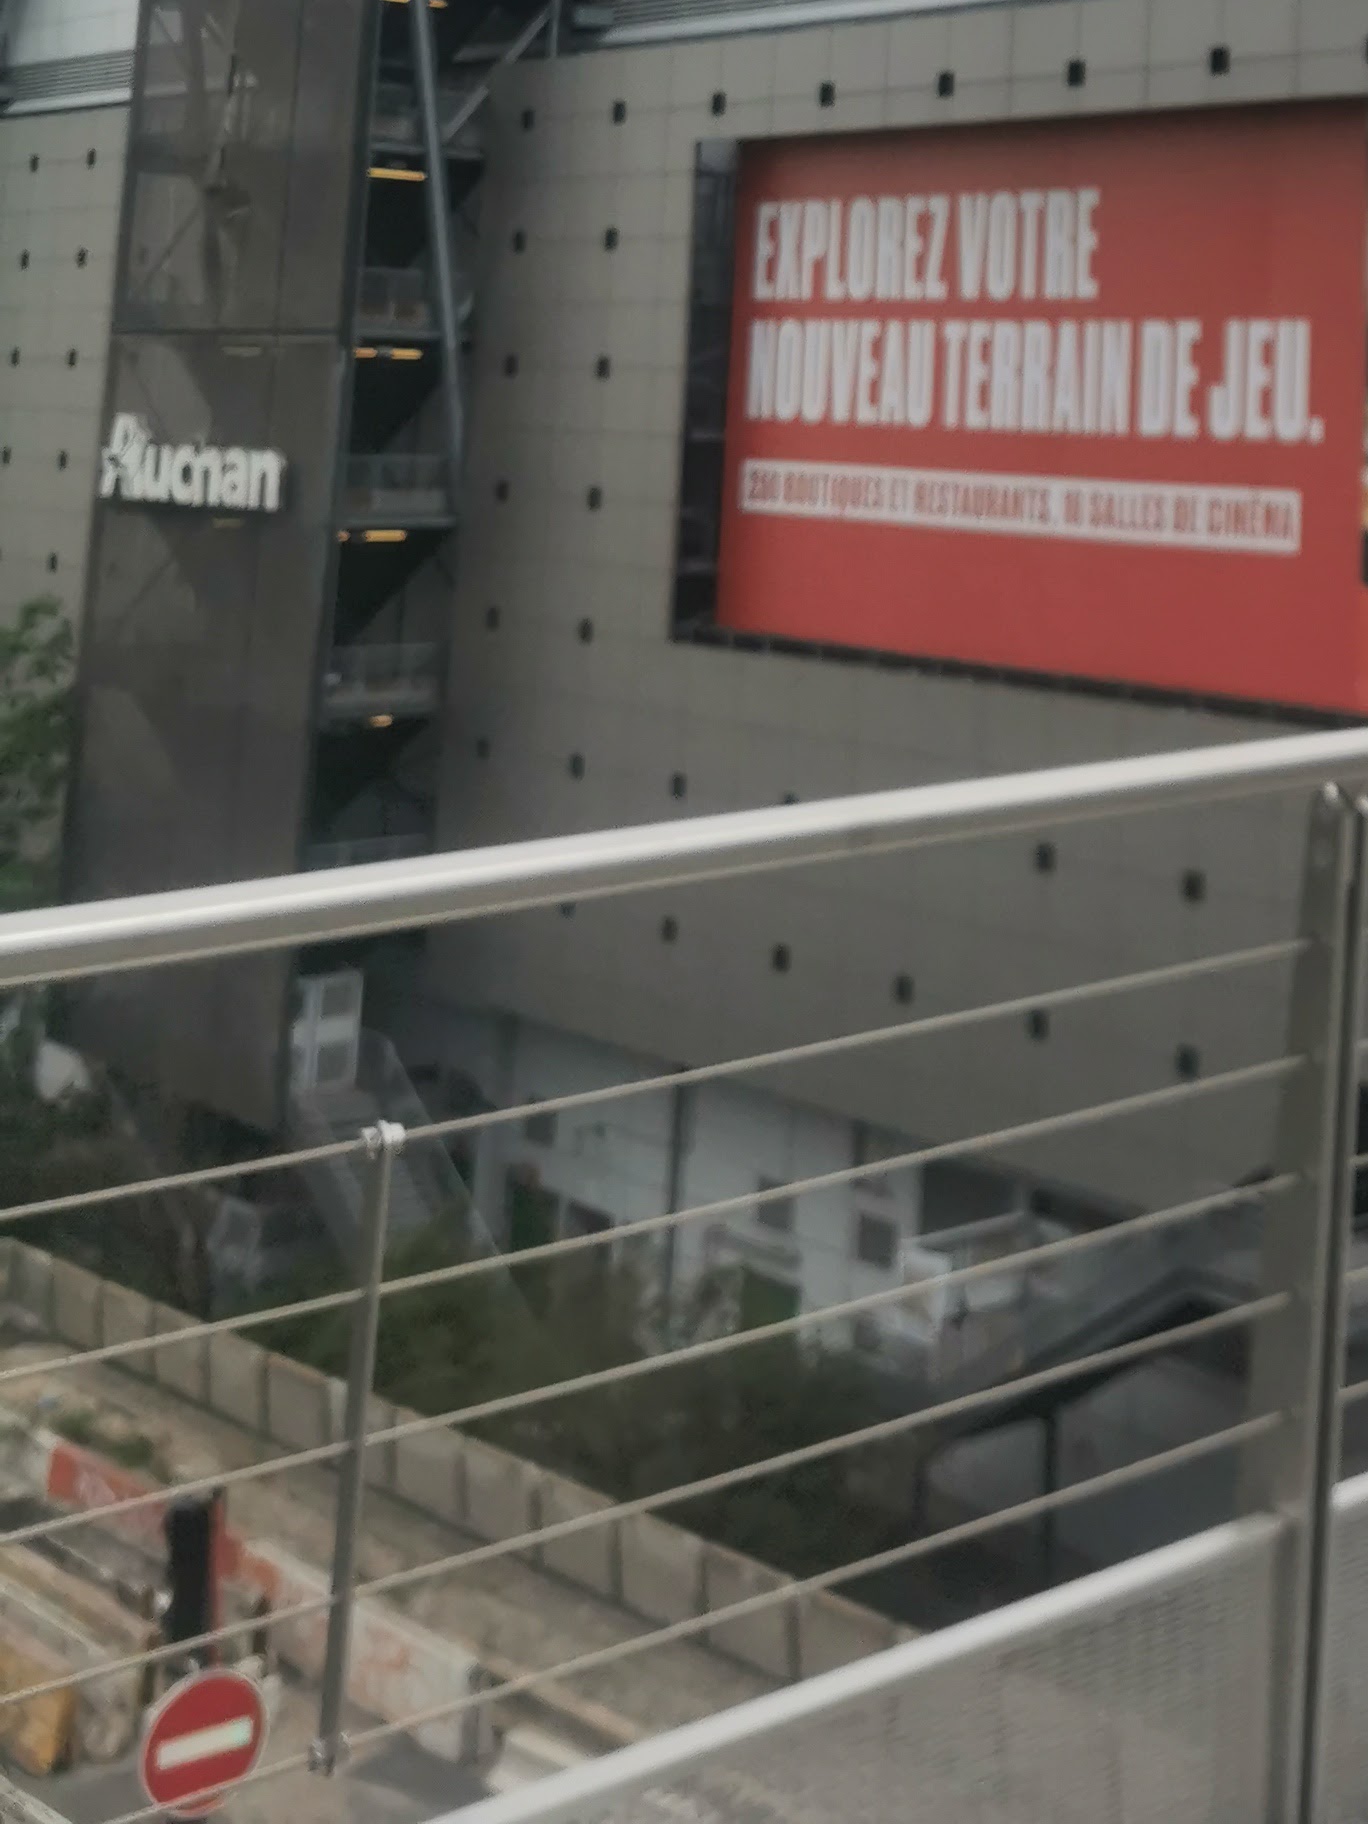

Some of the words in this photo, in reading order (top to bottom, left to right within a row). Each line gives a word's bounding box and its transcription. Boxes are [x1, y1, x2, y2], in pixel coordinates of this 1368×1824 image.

[754, 192, 950, 302] EXPLOREZ
[958, 187, 1100, 301] VOTRE
[747, 318, 934, 428] NOUVEAU
[942, 318, 1131, 437] TERRAIN
[1140, 318, 1201, 441] DE
[1208, 318, 1324, 445] JEU.
